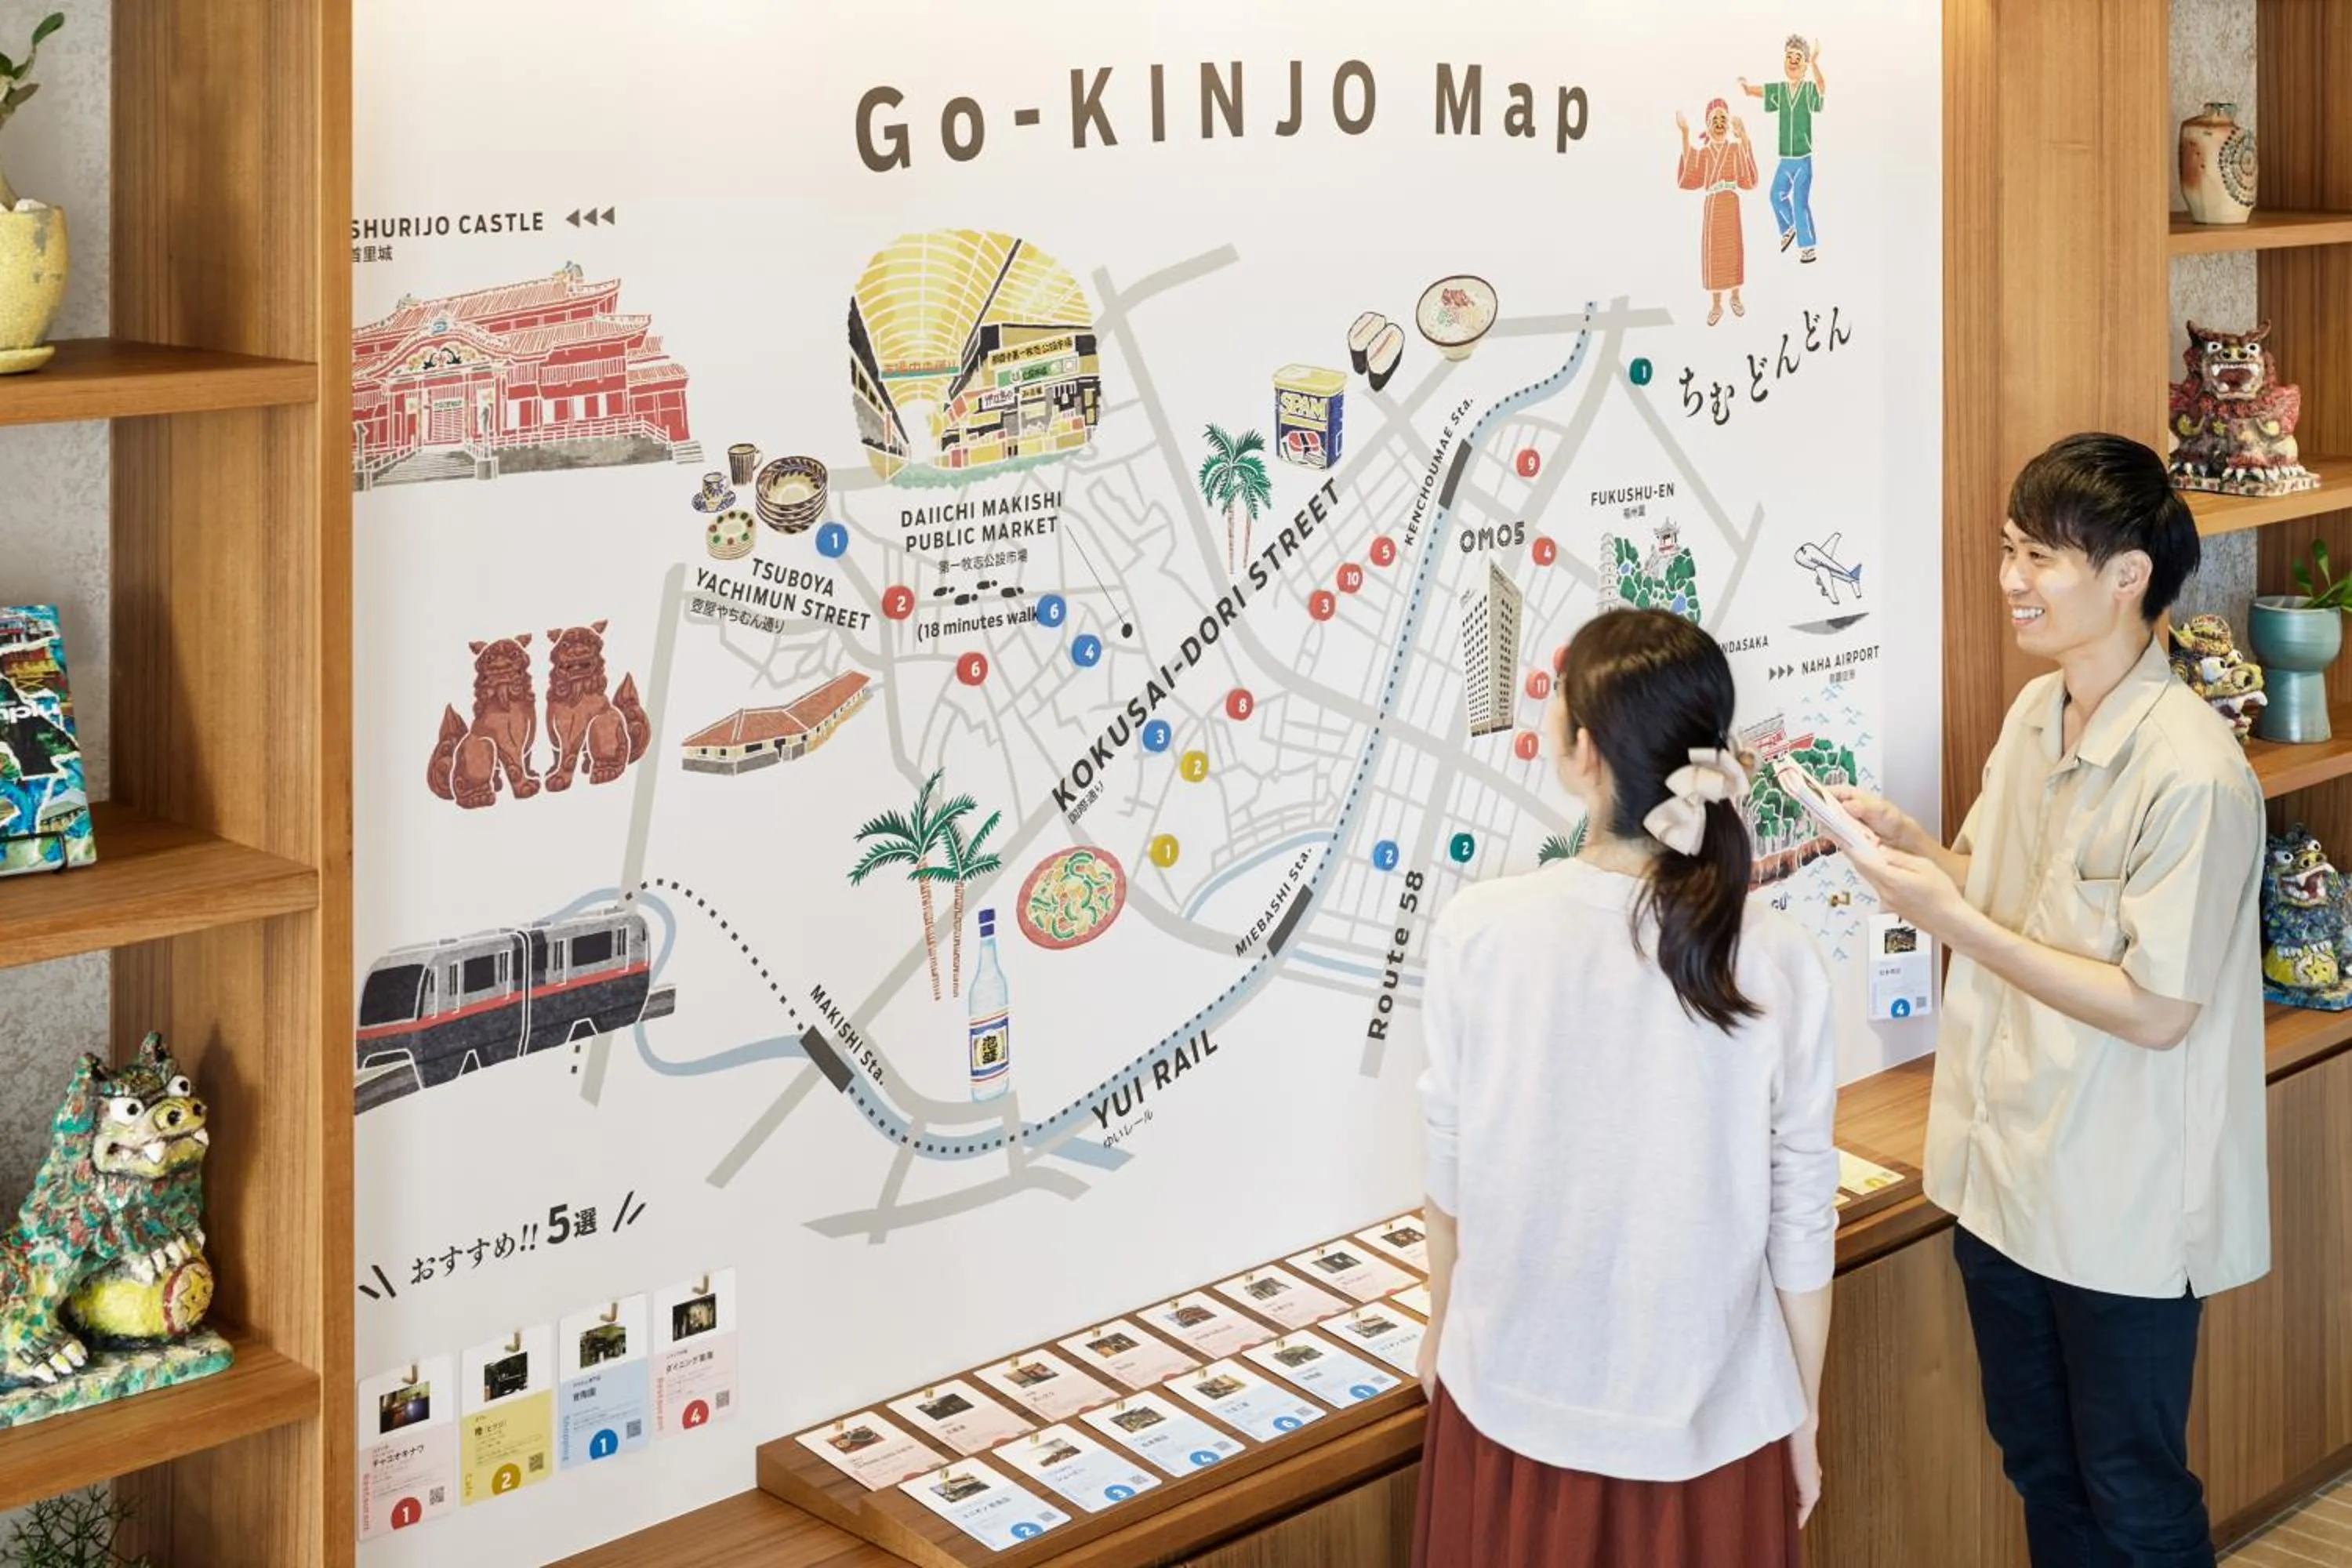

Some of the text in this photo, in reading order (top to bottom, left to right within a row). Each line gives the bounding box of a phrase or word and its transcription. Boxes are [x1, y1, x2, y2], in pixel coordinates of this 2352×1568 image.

[855, 59, 1588, 173] Go-KINJO Map
[351, 212, 543, 240] SHURIJO CASTLE
[351, 245, 393, 263] 首里城
[1679, 307, 1852, 426] ちむどんどん
[1279, 391, 1327, 420] SPAM
[1404, 397, 1474, 546] KENCHOUMAE Sta.
[901, 491, 1062, 528] DAIICHI MAKISHI
[1591, 483, 1674, 509] FUKUSHU-EN
[906, 515, 1058, 553] PUBLIC MARKET
[1460, 521, 1525, 554] OMO5
[752, 557, 833, 597] TSUBOYA
[1347, 572, 1360, 586] 10
[697, 567, 871, 630] YACHIMUN STREET
[917, 622, 940, 643] (18
[943, 614, 1004, 636] minutes
[1052, 477, 1338, 812] KOKUSAI-DORI STREET
[1718, 636, 1769, 654] NDASAKA
[1802, 645, 1879, 674] NAHA AIRPORT
[1234, 849, 1312, 957] MIEBASHI Sta.
[1367, 871, 1423, 1040] Route 58
[810, 984, 884, 1087] MAKISHI Sta.
[1091, 1030, 1218, 1130] YUI RAIL
[1103, 1111, 1153, 1150] ゆいレール
